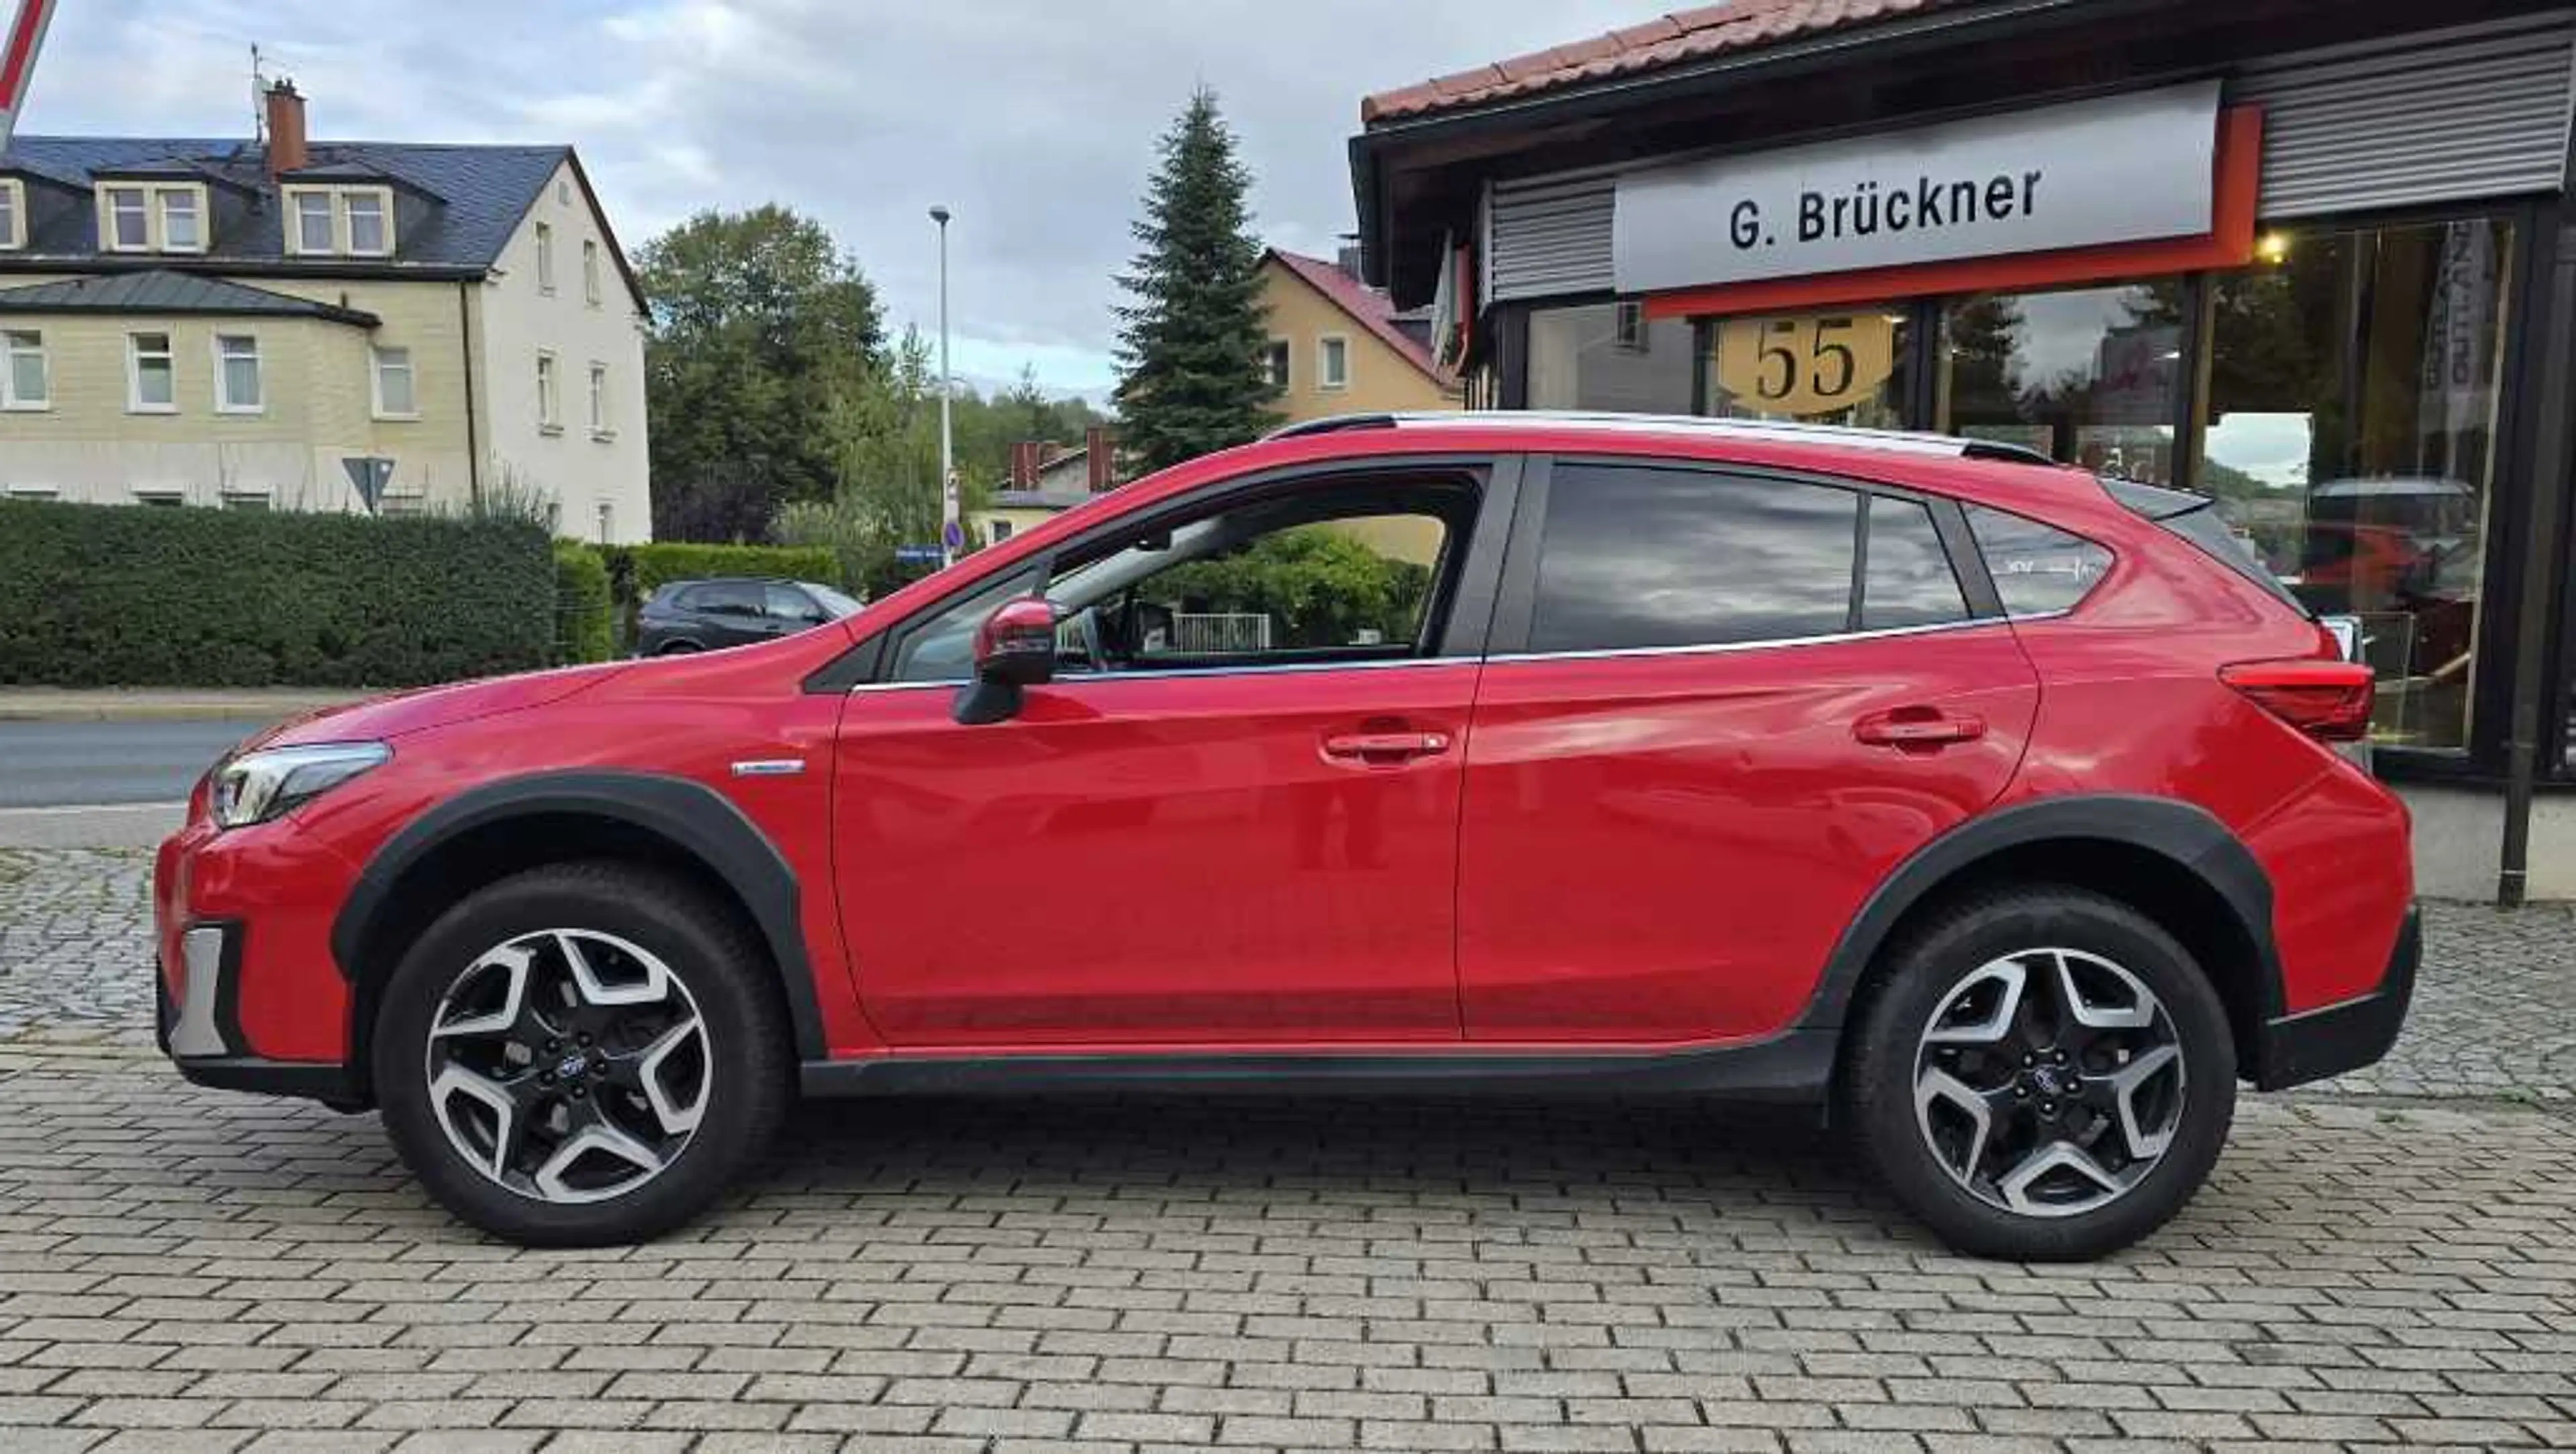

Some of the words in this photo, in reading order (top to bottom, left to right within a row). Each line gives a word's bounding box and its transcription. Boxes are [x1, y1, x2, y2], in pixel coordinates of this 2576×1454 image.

[1730, 199, 1774, 249] G.
[1799, 170, 2042, 242] Brückner
[1756, 317, 1854, 399] 55
